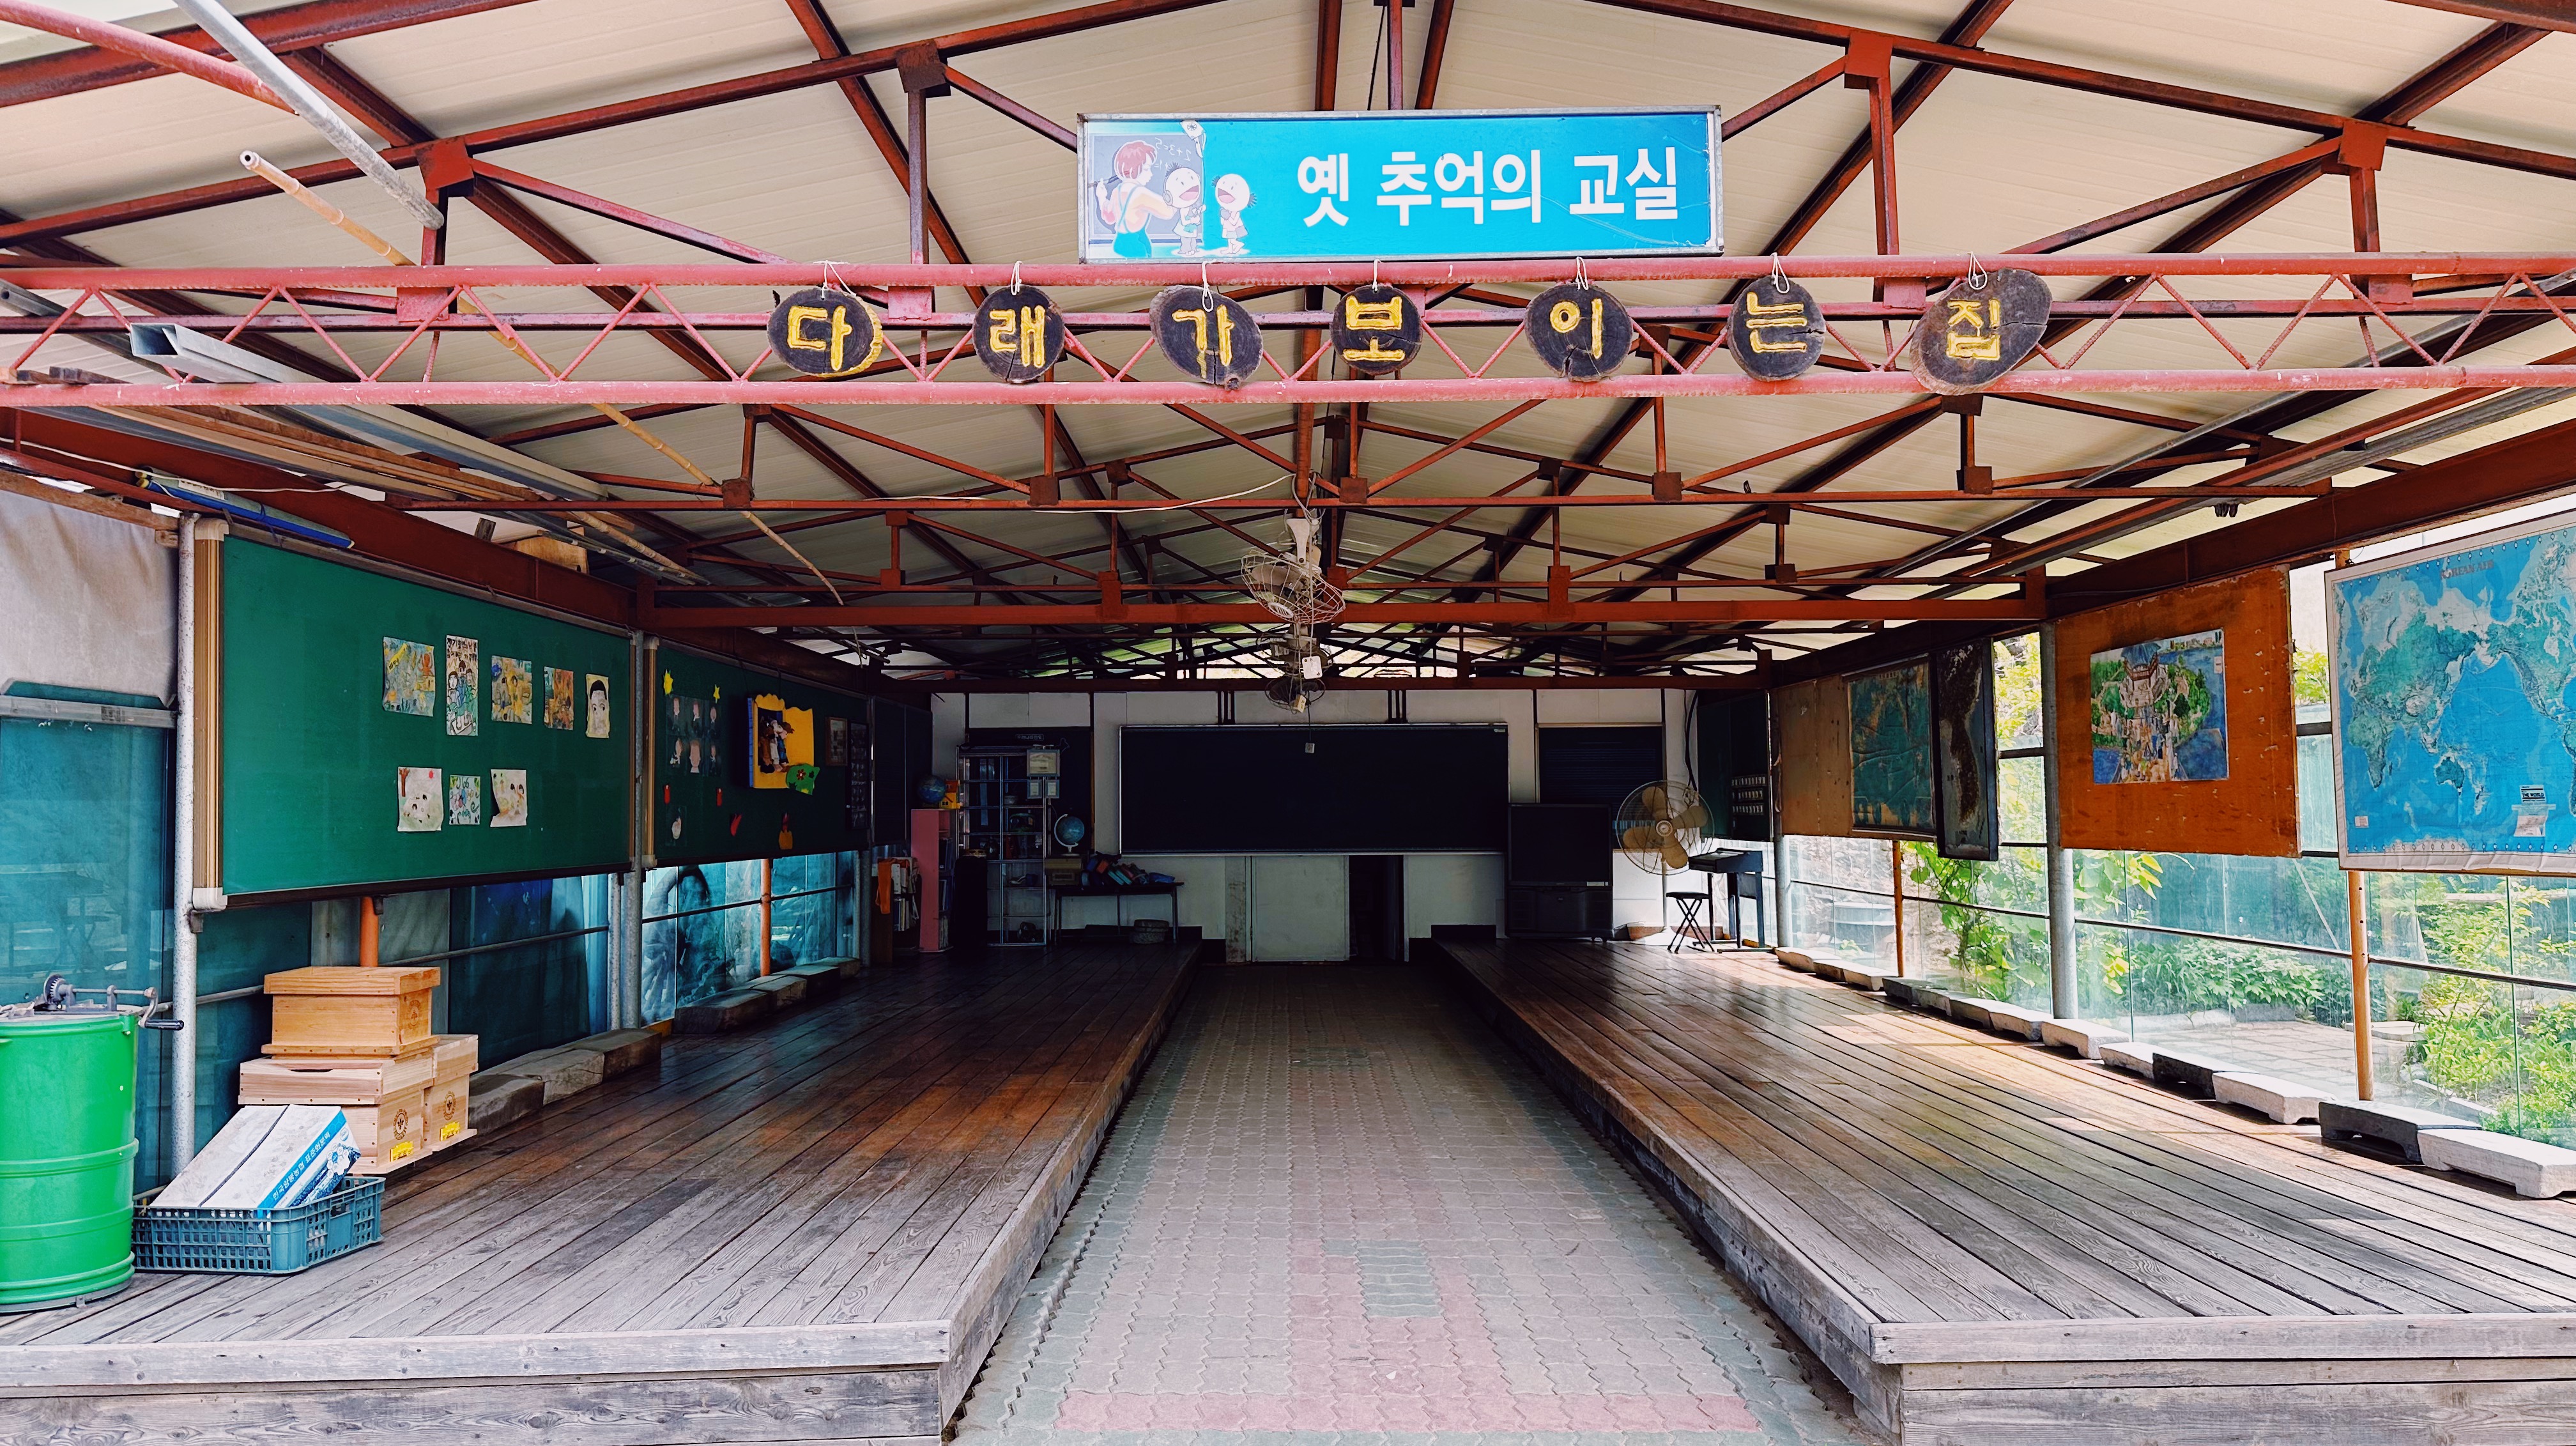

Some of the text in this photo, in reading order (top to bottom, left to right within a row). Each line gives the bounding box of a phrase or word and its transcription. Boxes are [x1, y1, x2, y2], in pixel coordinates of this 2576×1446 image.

[1297, 147, 1678, 227] 옛 추억의 교실
[786, 291, 2002, 378] 다 래 가 보 이 는 집
[2441, 559, 2494, 579] KOREAN AIR
